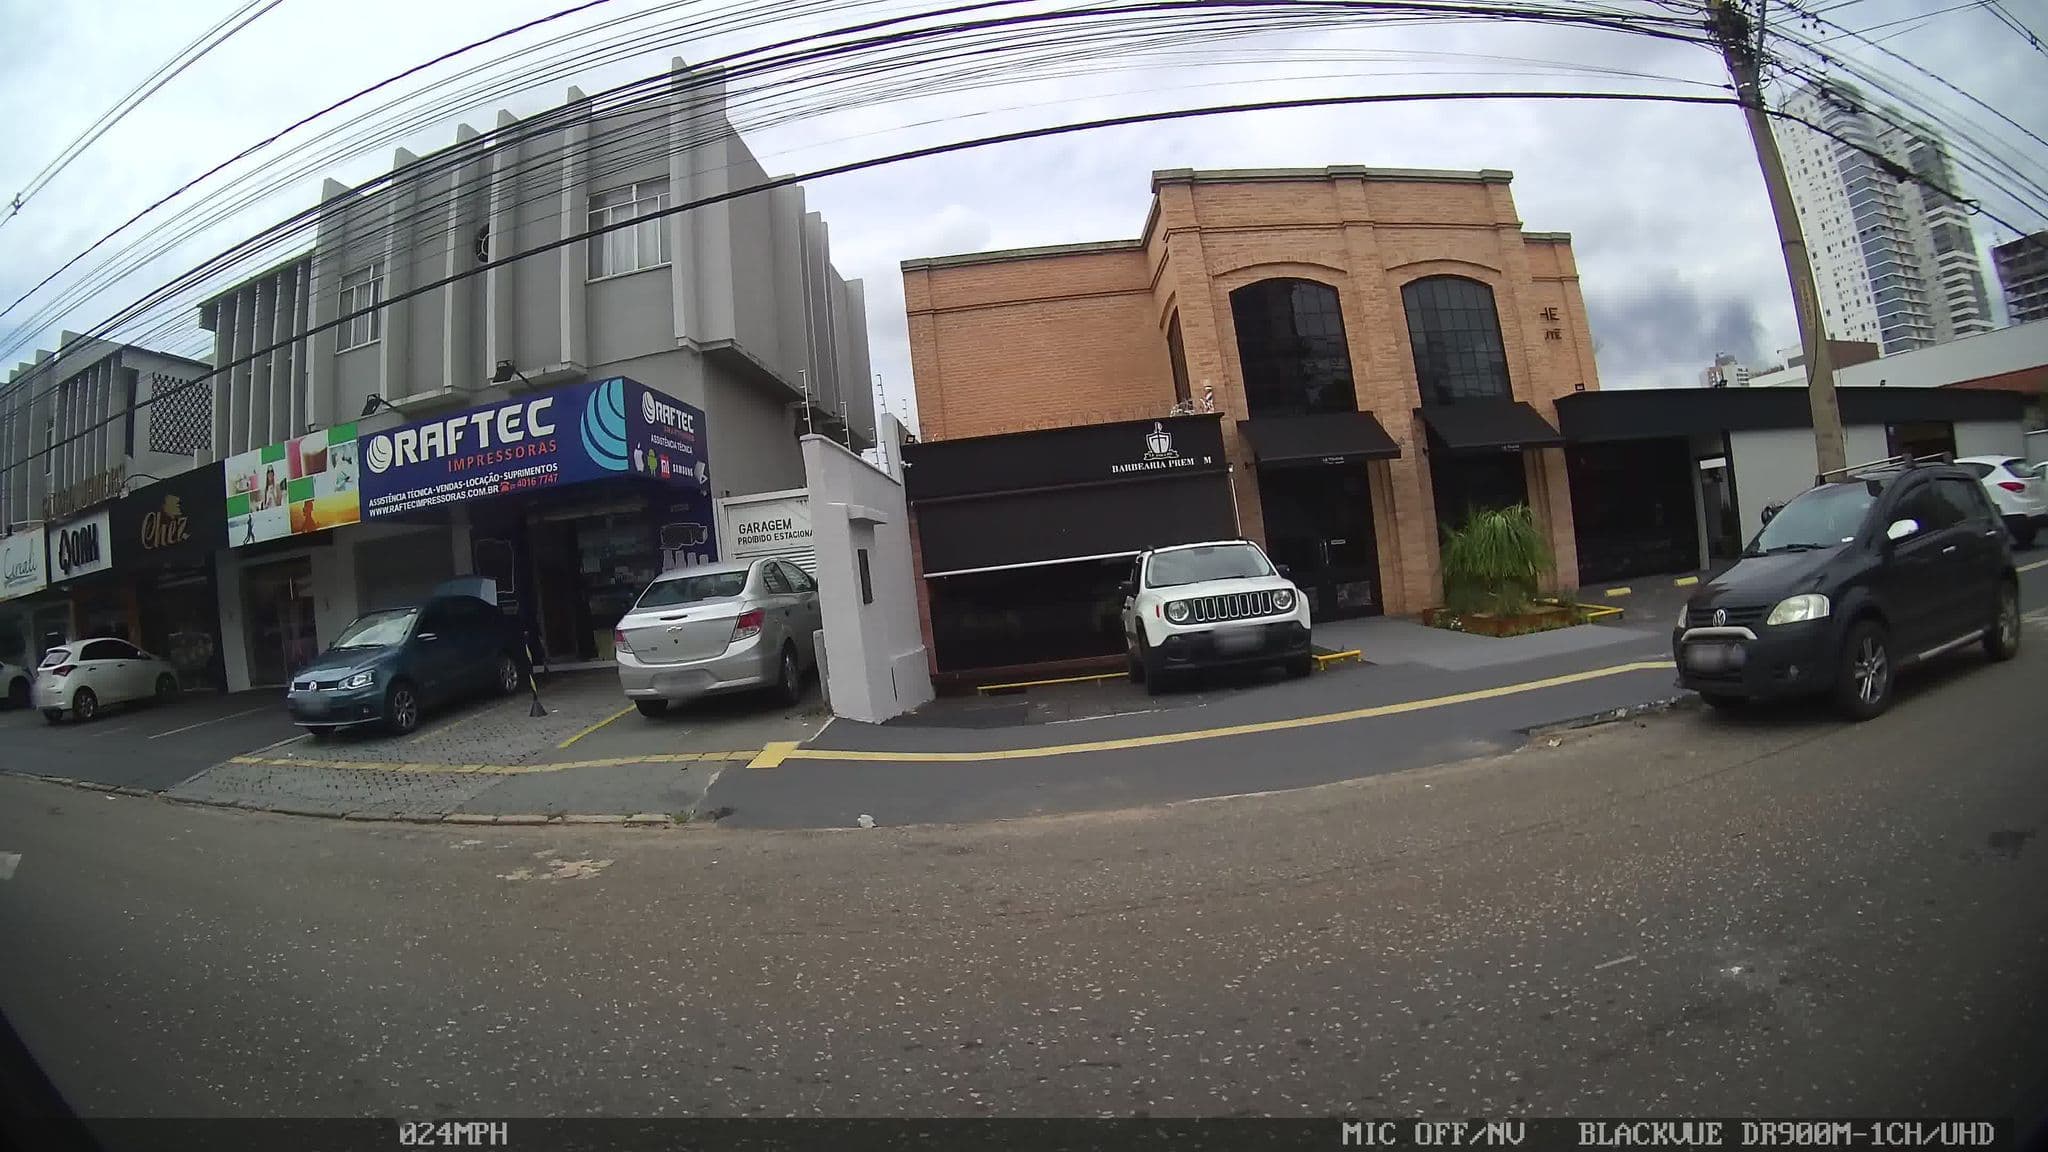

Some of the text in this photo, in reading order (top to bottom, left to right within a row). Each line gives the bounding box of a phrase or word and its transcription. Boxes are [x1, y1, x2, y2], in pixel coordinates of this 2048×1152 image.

[655, 400, 694, 433] RAFTEC
[394, 396, 556, 467] RAFTEC
[448, 439, 558, 472] IMPRESSORAS
[1112, 461, 1166, 473] BARBEARIA
[738, 517, 792, 535] GARAGEM
[737, 534, 772, 546] PROIBIDO
